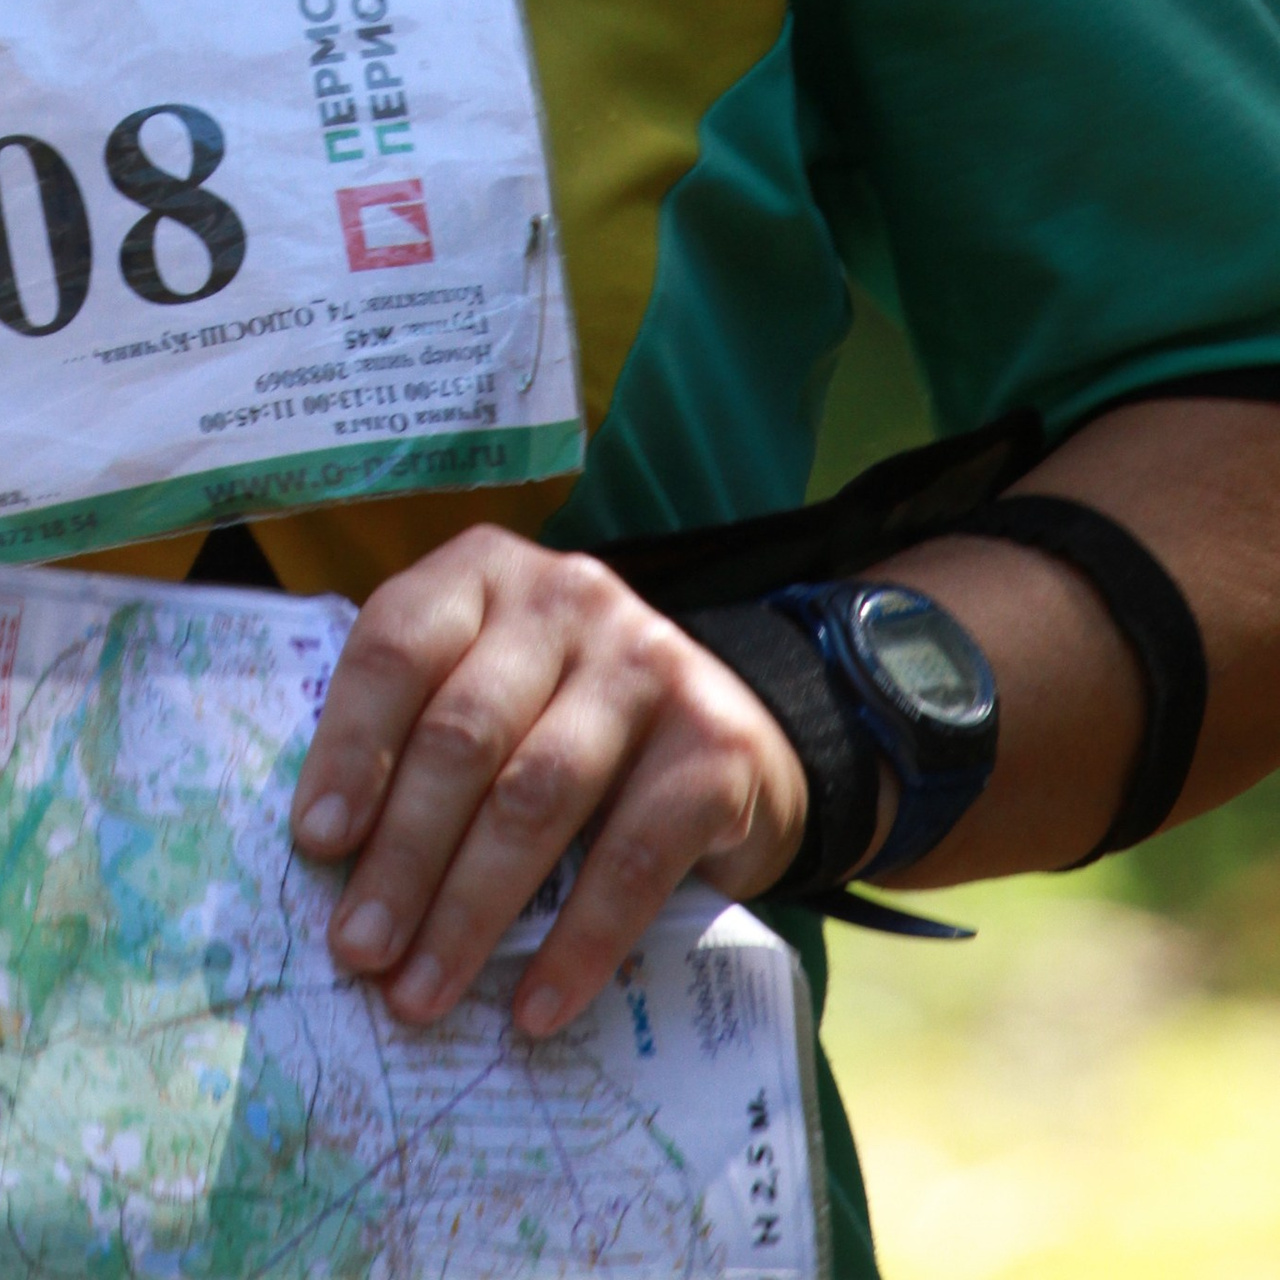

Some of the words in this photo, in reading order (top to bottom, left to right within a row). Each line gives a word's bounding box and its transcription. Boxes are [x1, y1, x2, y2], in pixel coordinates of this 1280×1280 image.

[302, 384, 397, 416] 11:13:00
[404, 372, 496, 401] 11:37:00
[199, 397, 296, 433] 11:45:00
[333, 412, 409, 435] Ольга
[203, 440, 506, 506] www.o-perm.ru
[72, 510, 99, 532] 54
